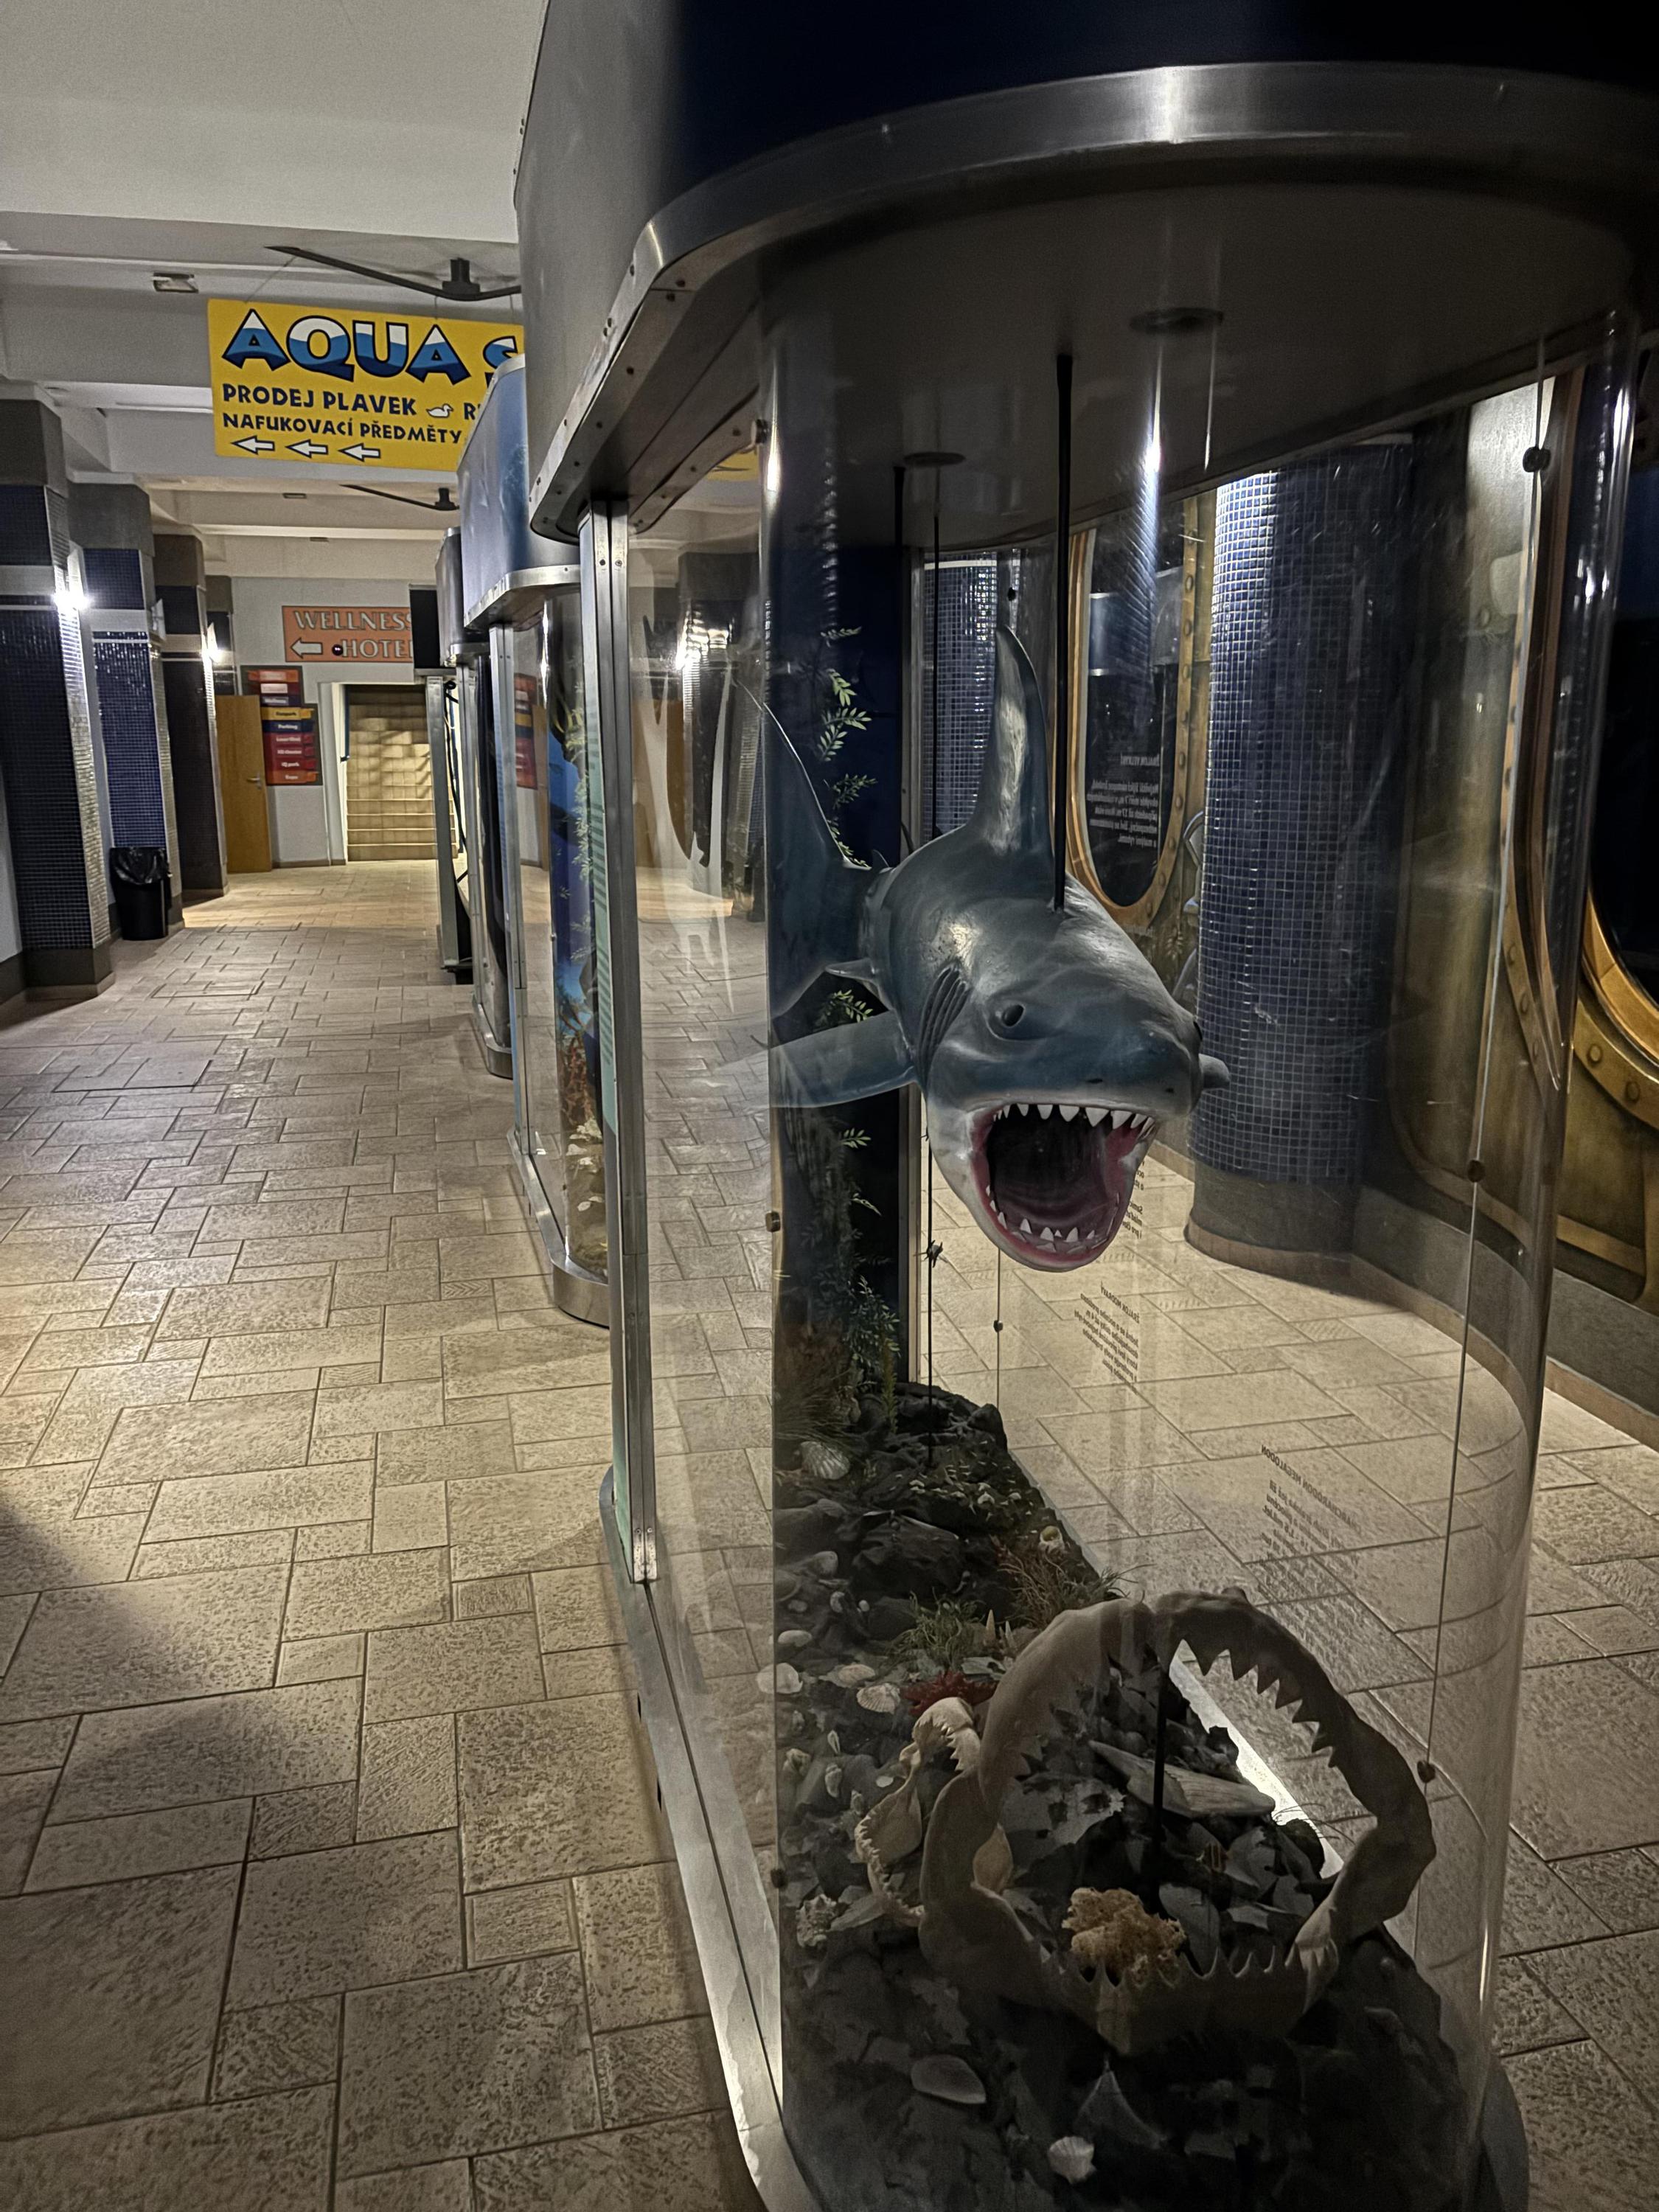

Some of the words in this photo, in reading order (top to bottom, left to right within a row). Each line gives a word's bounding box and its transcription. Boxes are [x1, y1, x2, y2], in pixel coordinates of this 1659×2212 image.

[221, 308, 471, 386] AQUA
[222, 383, 314, 408] PRODEJ
[324, 392, 417, 416] PLAVEK
[463, 403, 481, 420] R
[223, 413, 353, 437] NAFUKOVACÍ
[360, 420, 462, 444] PŘEDMĚTY
